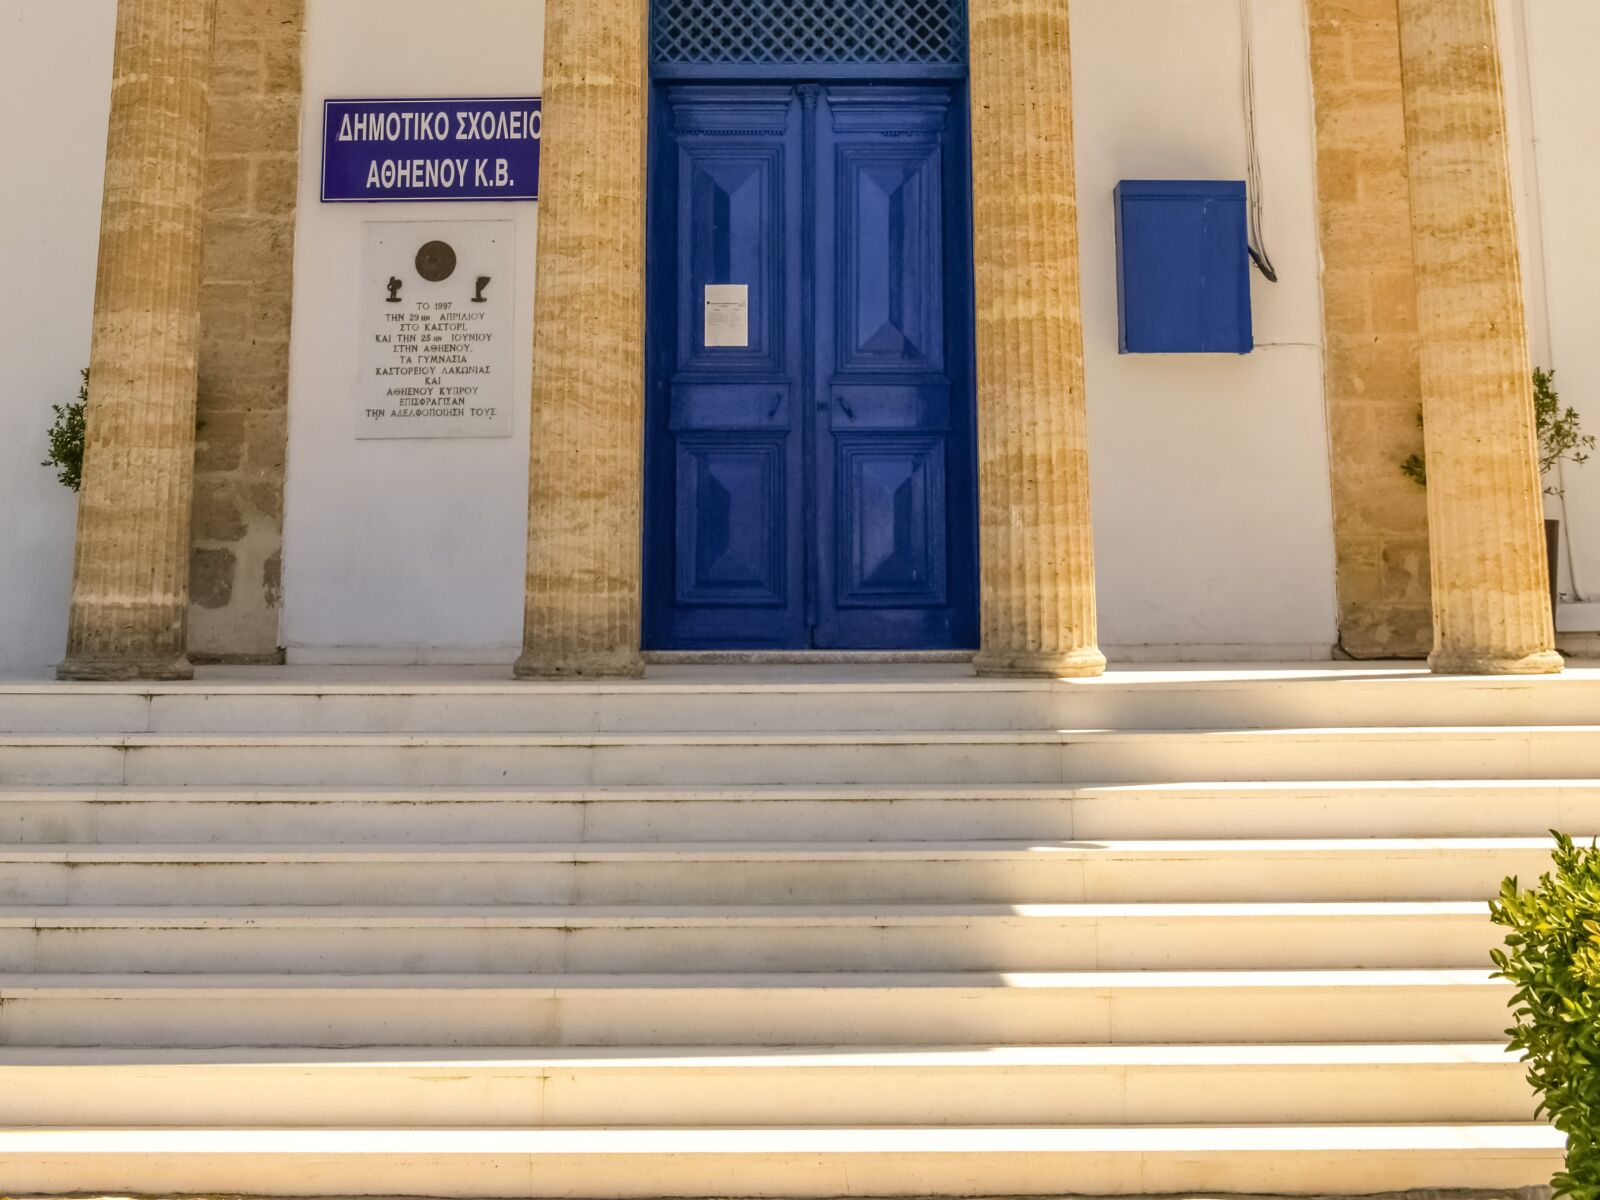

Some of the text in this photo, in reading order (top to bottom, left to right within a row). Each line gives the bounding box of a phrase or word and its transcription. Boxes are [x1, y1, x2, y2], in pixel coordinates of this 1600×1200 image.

[338, 110, 541, 141] ΔΗΜΟΤΙΚΟ ΣΧΟΛΕΙΟ
[366, 158, 514, 188] ΑΘΗΕΝΟΥ Κ.Β.
[416, 302, 453, 310] ΤΟ 1997
[385, 313, 404, 321] ΤΗΝ
[439, 312, 485, 321] ΑΠΡΙΛΙΟΥ
[400, 323, 419, 331] ΣΤΟ
[375, 334, 392, 342] ΚΑΙ
[397, 334, 416, 342] ΤΗΝ
[451, 333, 492, 341] ΙΟΥΝΙΟΥ
[393, 344, 418, 352] ΣΤΗΝ
[400, 355, 467, 364] ΤΑ ΓΥΜΝΑΣΙΑ
[375, 365, 491, 375] ΚΑΣΤΟΡΕΙΟΥ ΛΑΚΩΝΙΑΣ
[425, 376, 441, 385] ΚΑΙ
[386, 386, 479, 396] ΑΘΗΕΝΟΥ ΚΥΠΡΟΥ
[399, 397, 465, 406] ΕΠΙΣΦΡΑΓΙΣΑΝ
[365, 409, 385, 417] ΤΗΝ
[470, 408, 497, 416] ΤΟΥΣ
